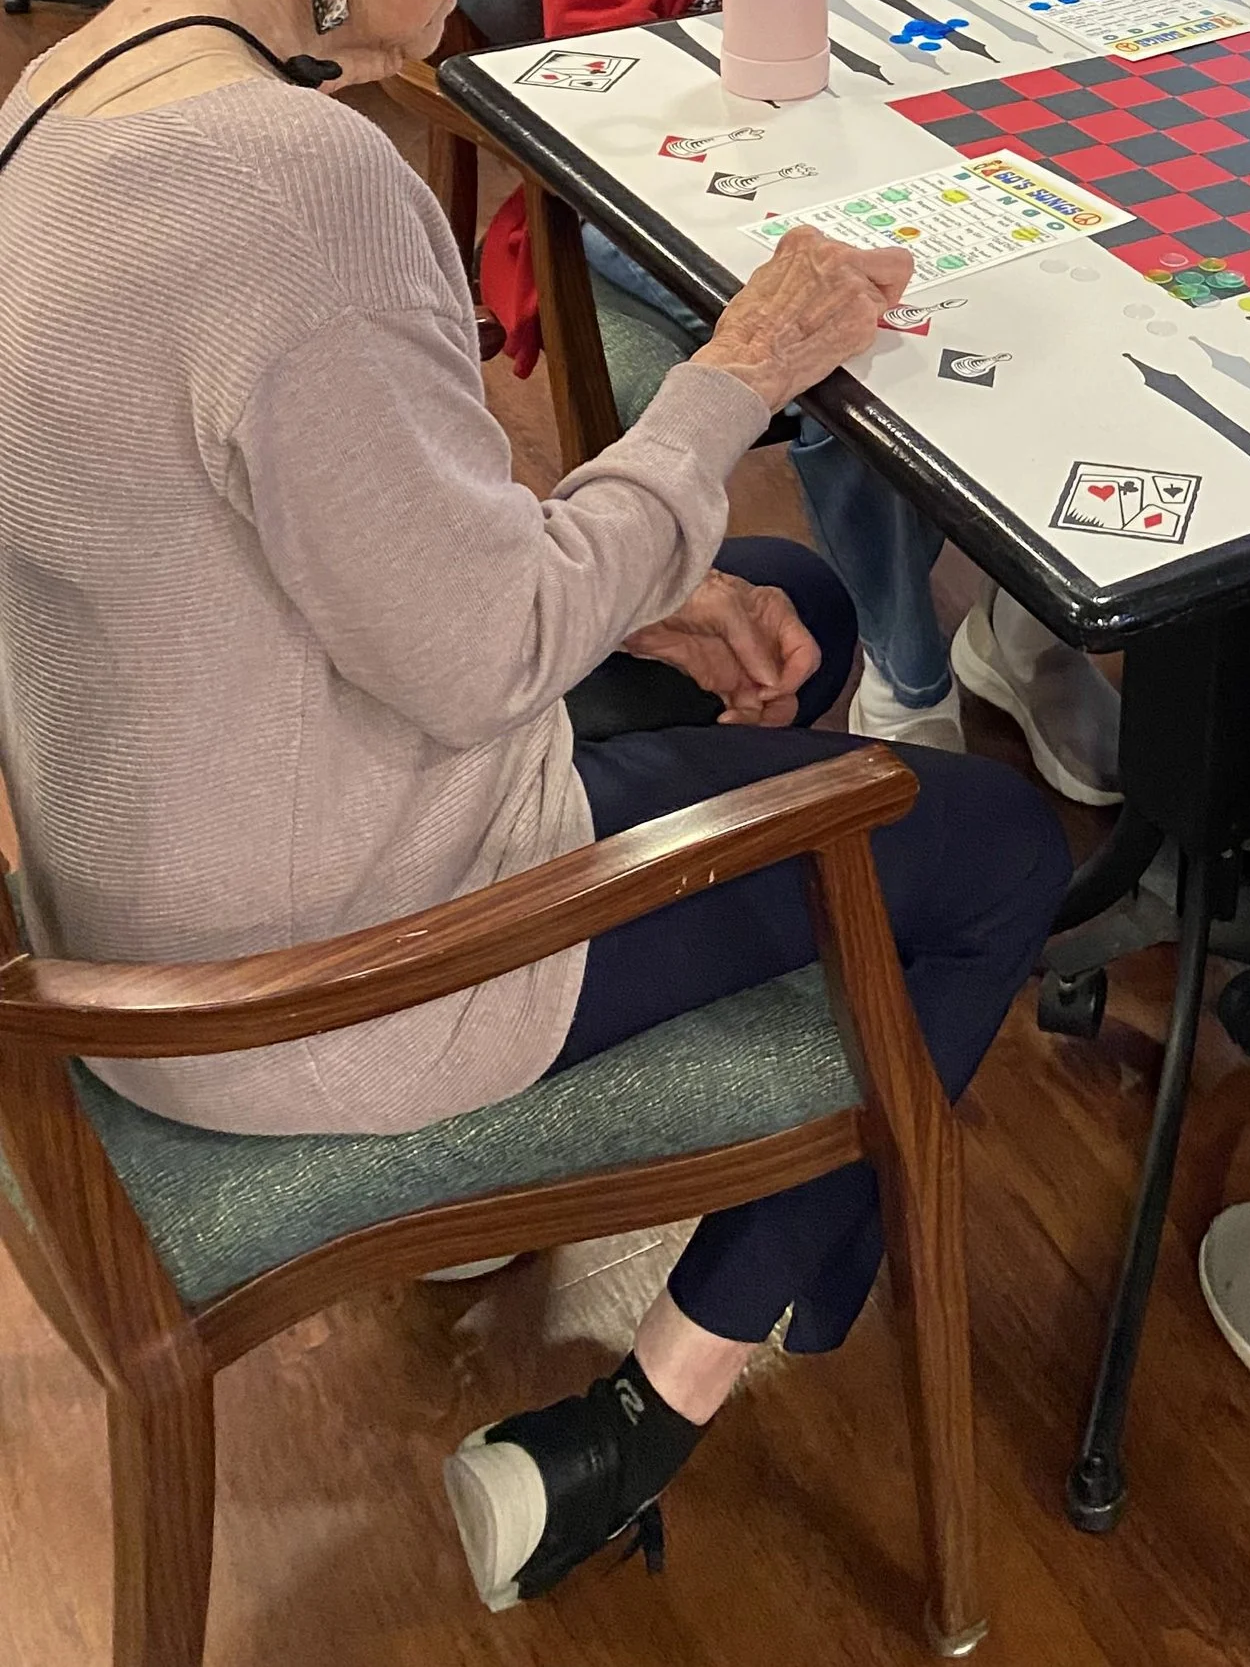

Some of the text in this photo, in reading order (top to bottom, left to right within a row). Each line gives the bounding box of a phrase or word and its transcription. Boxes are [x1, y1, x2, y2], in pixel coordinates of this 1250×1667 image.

[1134, 30, 1187, 48] SONGS
[993, 171, 1084, 216] 60'S SONGS
